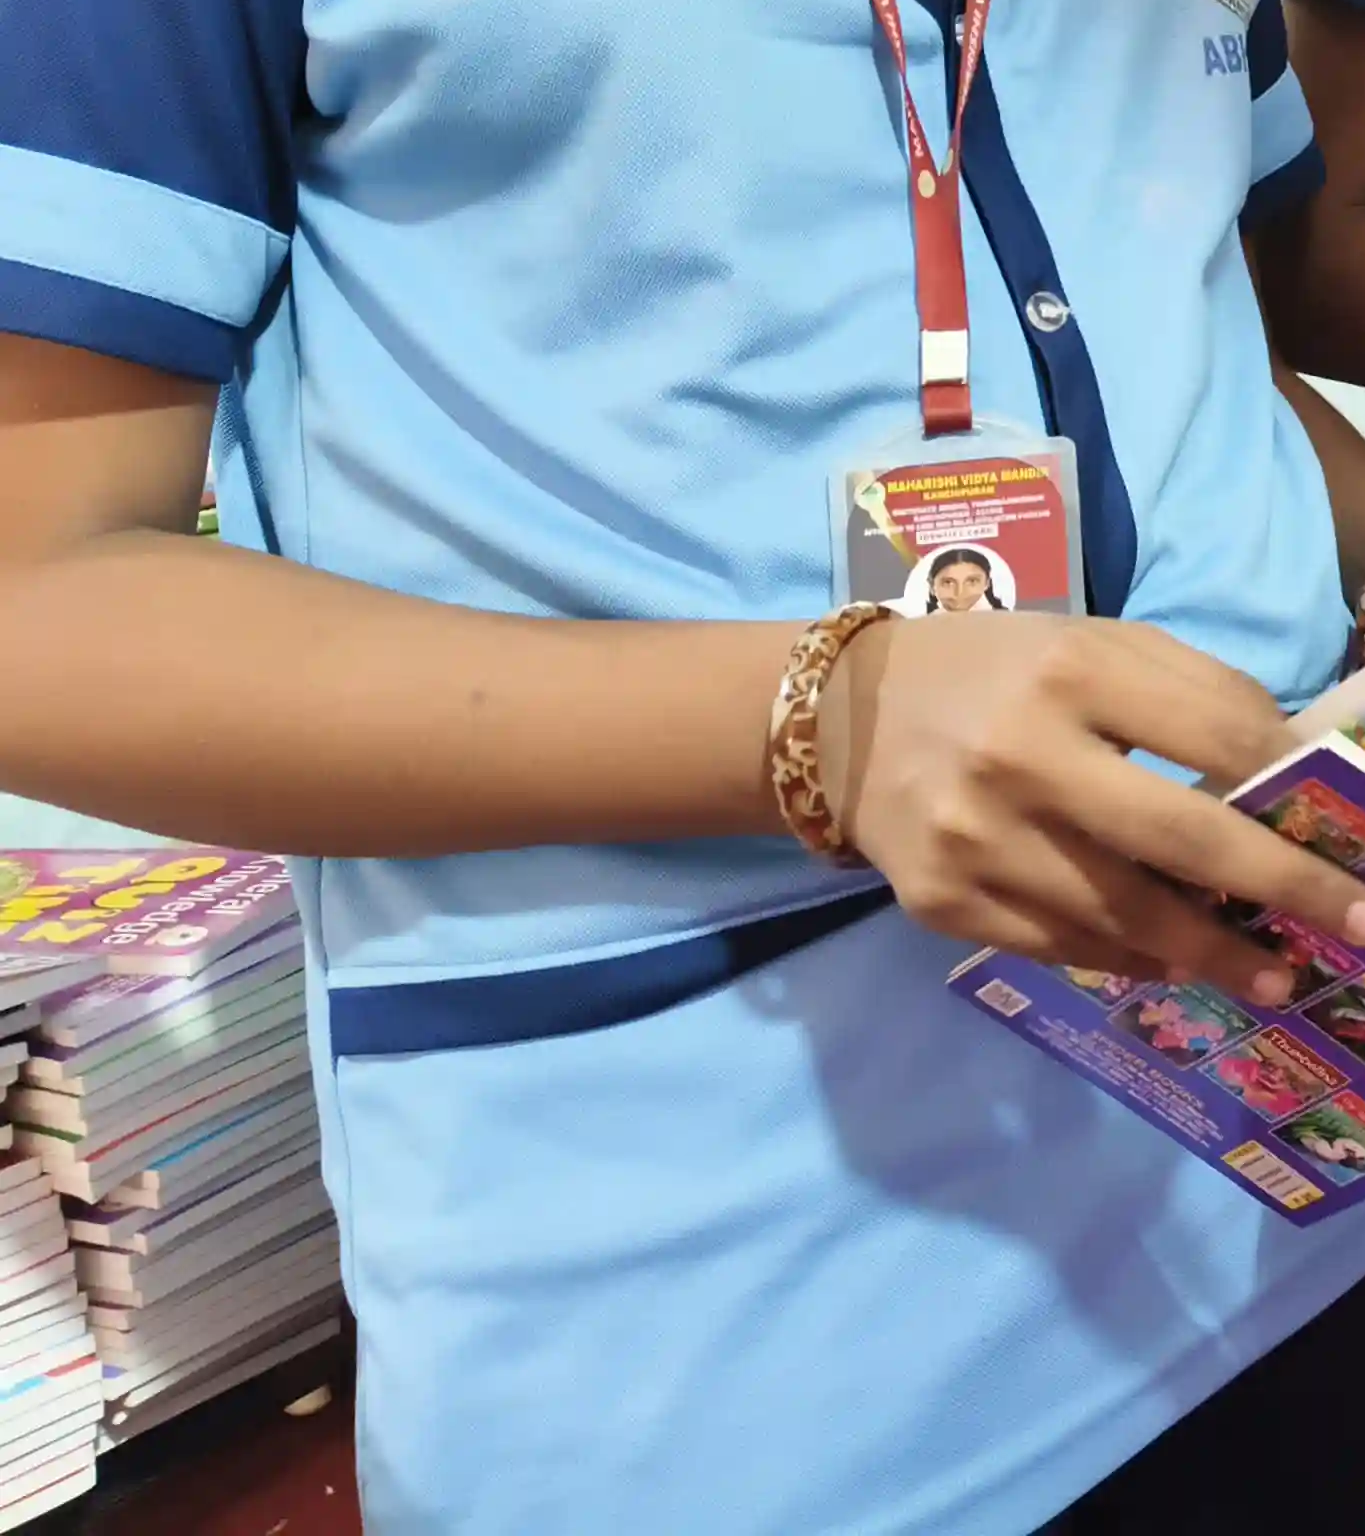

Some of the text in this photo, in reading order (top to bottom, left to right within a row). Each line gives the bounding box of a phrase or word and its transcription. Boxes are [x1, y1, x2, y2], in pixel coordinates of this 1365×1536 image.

[887, 466, 1050, 494] MAHARISHI VIDYA MANDIR
[100, 854, 287, 945] Knowledge
